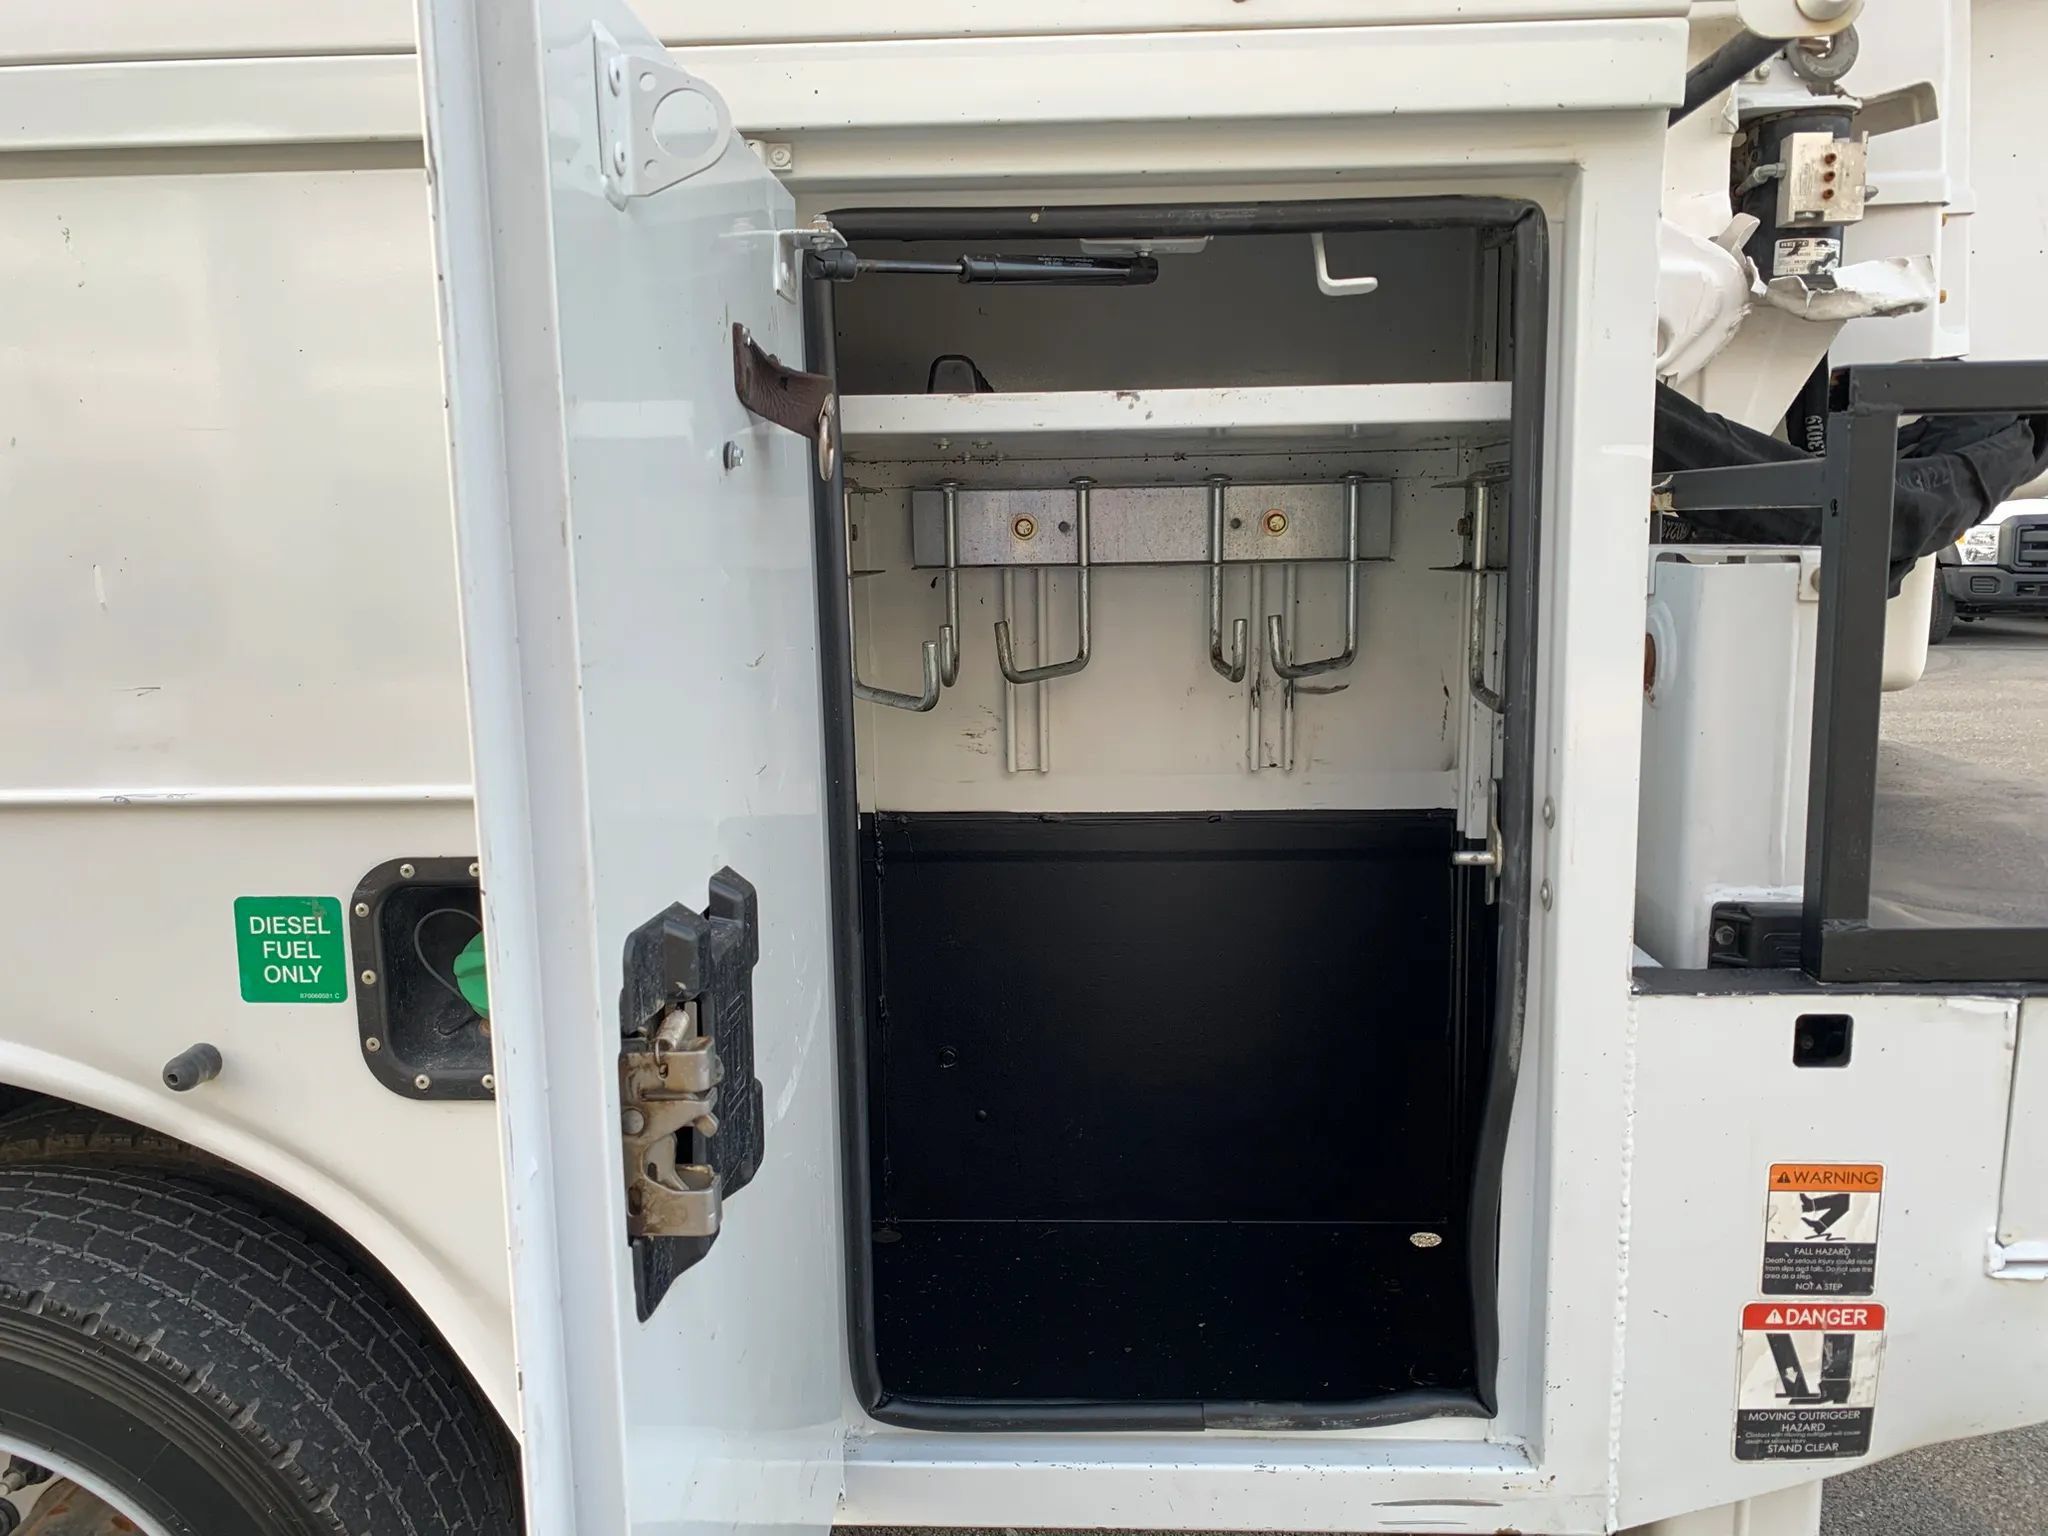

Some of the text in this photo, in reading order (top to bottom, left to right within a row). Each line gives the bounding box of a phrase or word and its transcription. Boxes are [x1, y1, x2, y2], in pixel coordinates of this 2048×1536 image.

[249, 916, 331, 934] DIESEL
[263, 941, 321, 959] FUEL
[264, 965, 323, 983] ONLY
[1793, 1171, 1879, 1185] WARNING
[1815, 1248, 1851, 1256] HAZARD
[1795, 1282, 1814, 1290] NOT
[1823, 1283, 1844, 1291] STEP
[1786, 1309, 1868, 1326] DANGER
[1748, 1411, 1861, 1421] MOVING OUTRIGGER
[1781, 1423, 1826, 1432] HAZARD
[1767, 1442, 1839, 1453] STAND CLEAR
